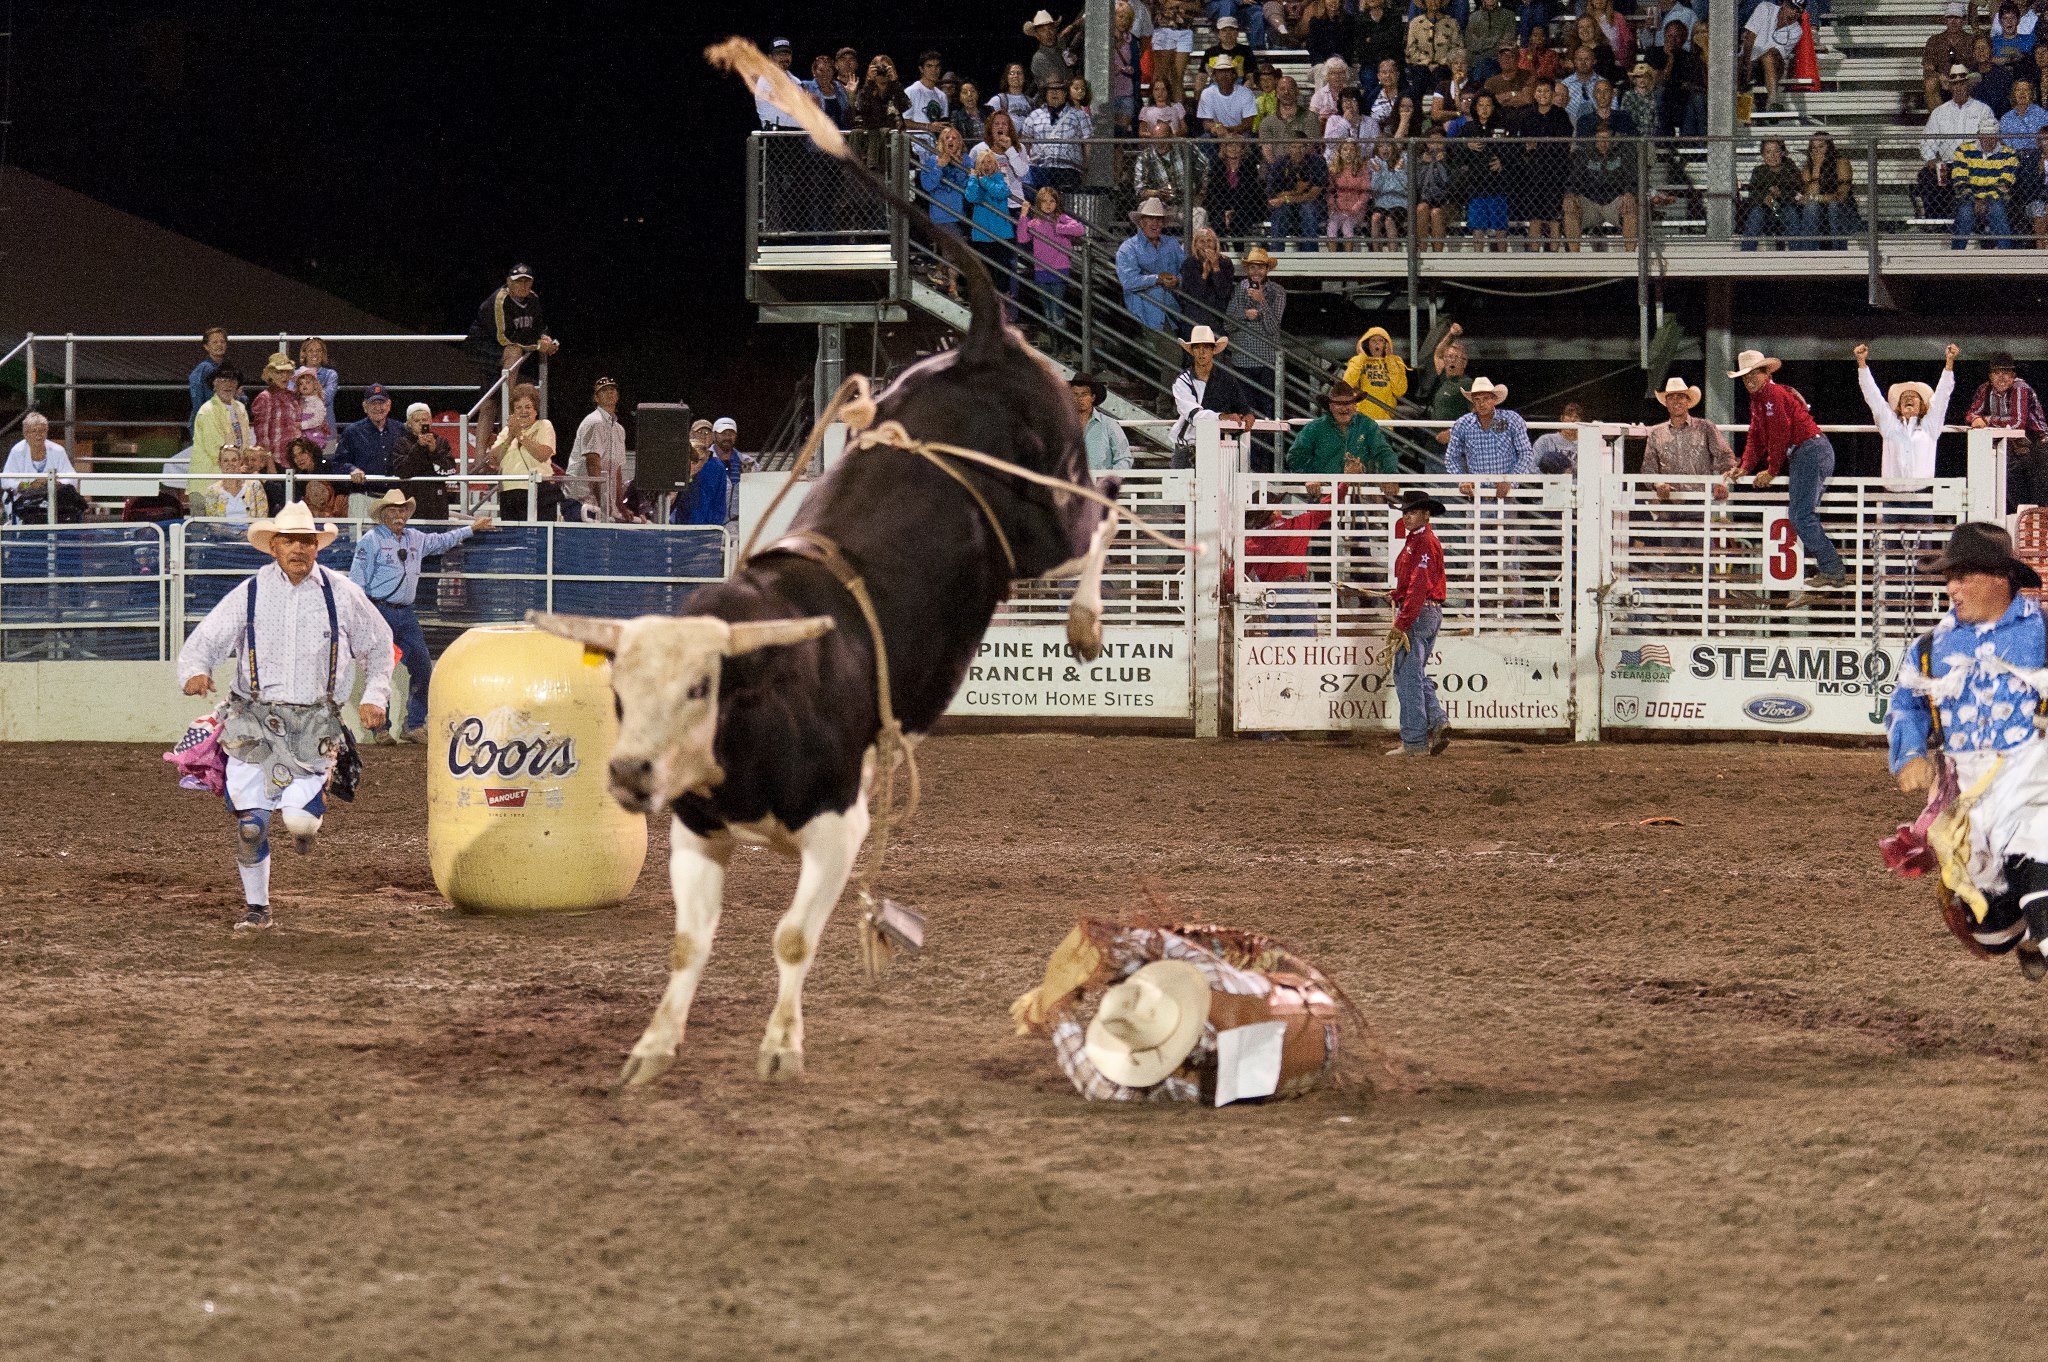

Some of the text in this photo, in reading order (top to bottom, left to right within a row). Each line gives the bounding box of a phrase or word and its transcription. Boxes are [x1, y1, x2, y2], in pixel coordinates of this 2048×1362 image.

[1769, 518, 1797, 580] 3
[977, 643, 1174, 659] PINE MONTAIN
[1246, 646, 1297, 666] ACES
[1303, 646, 1359, 666] HIGH
[1690, 646, 1904, 682] STEAMBO
[969, 666, 1151, 683] RANCH & CLUB
[1610, 670, 1671, 680] STEAMBOAT
[1818, 681, 1896, 695] MOTO
[1328, 700, 1392, 720] ROYAL
[1467, 699, 1559, 720] Industries
[1645, 701, 1706, 719] DODGE
[1758, 700, 1797, 717] Ford
[448, 716, 577, 777] Coors
[489, 790, 525, 804] BANQUET
